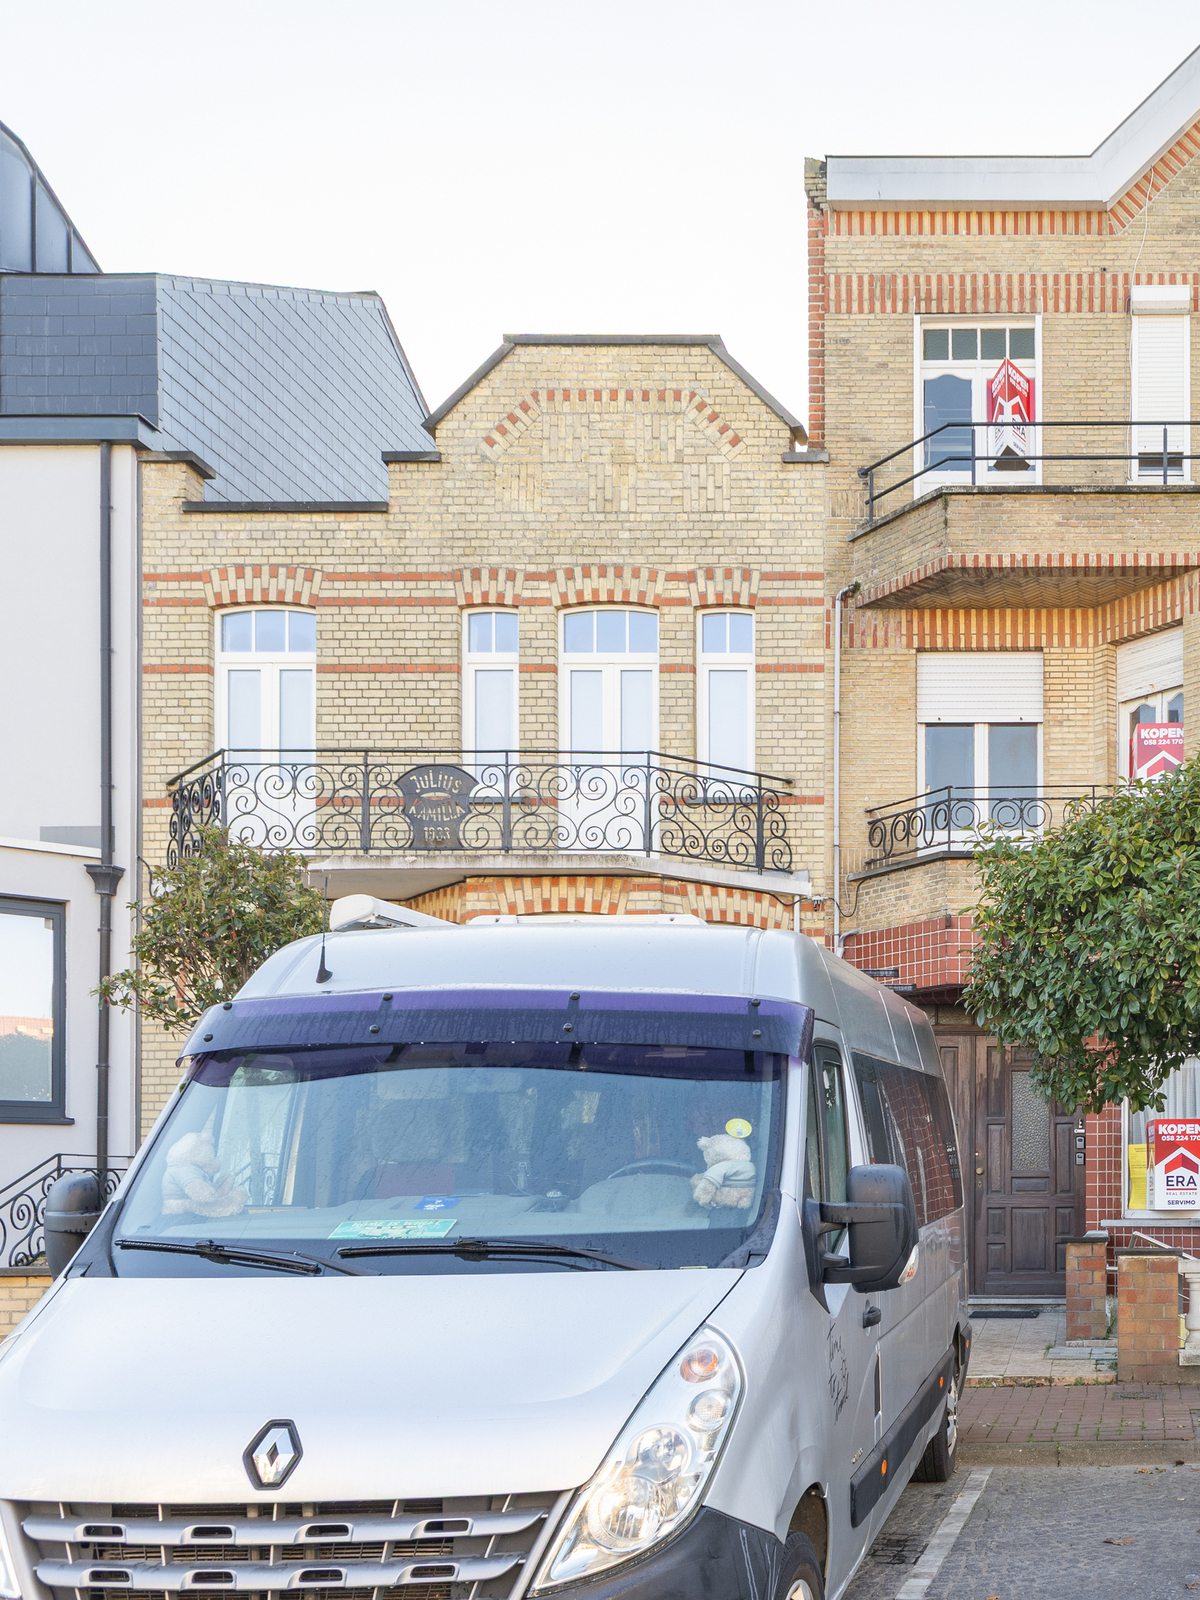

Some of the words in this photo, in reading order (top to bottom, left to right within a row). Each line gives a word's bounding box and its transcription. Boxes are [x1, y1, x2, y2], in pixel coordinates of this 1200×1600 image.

[1008, 364, 1029, 393] KOPEN
[1140, 728, 1184, 738] KOPEN
[410, 769, 462, 794] JULIUS
[1166, 1175, 1197, 1187] ERA
